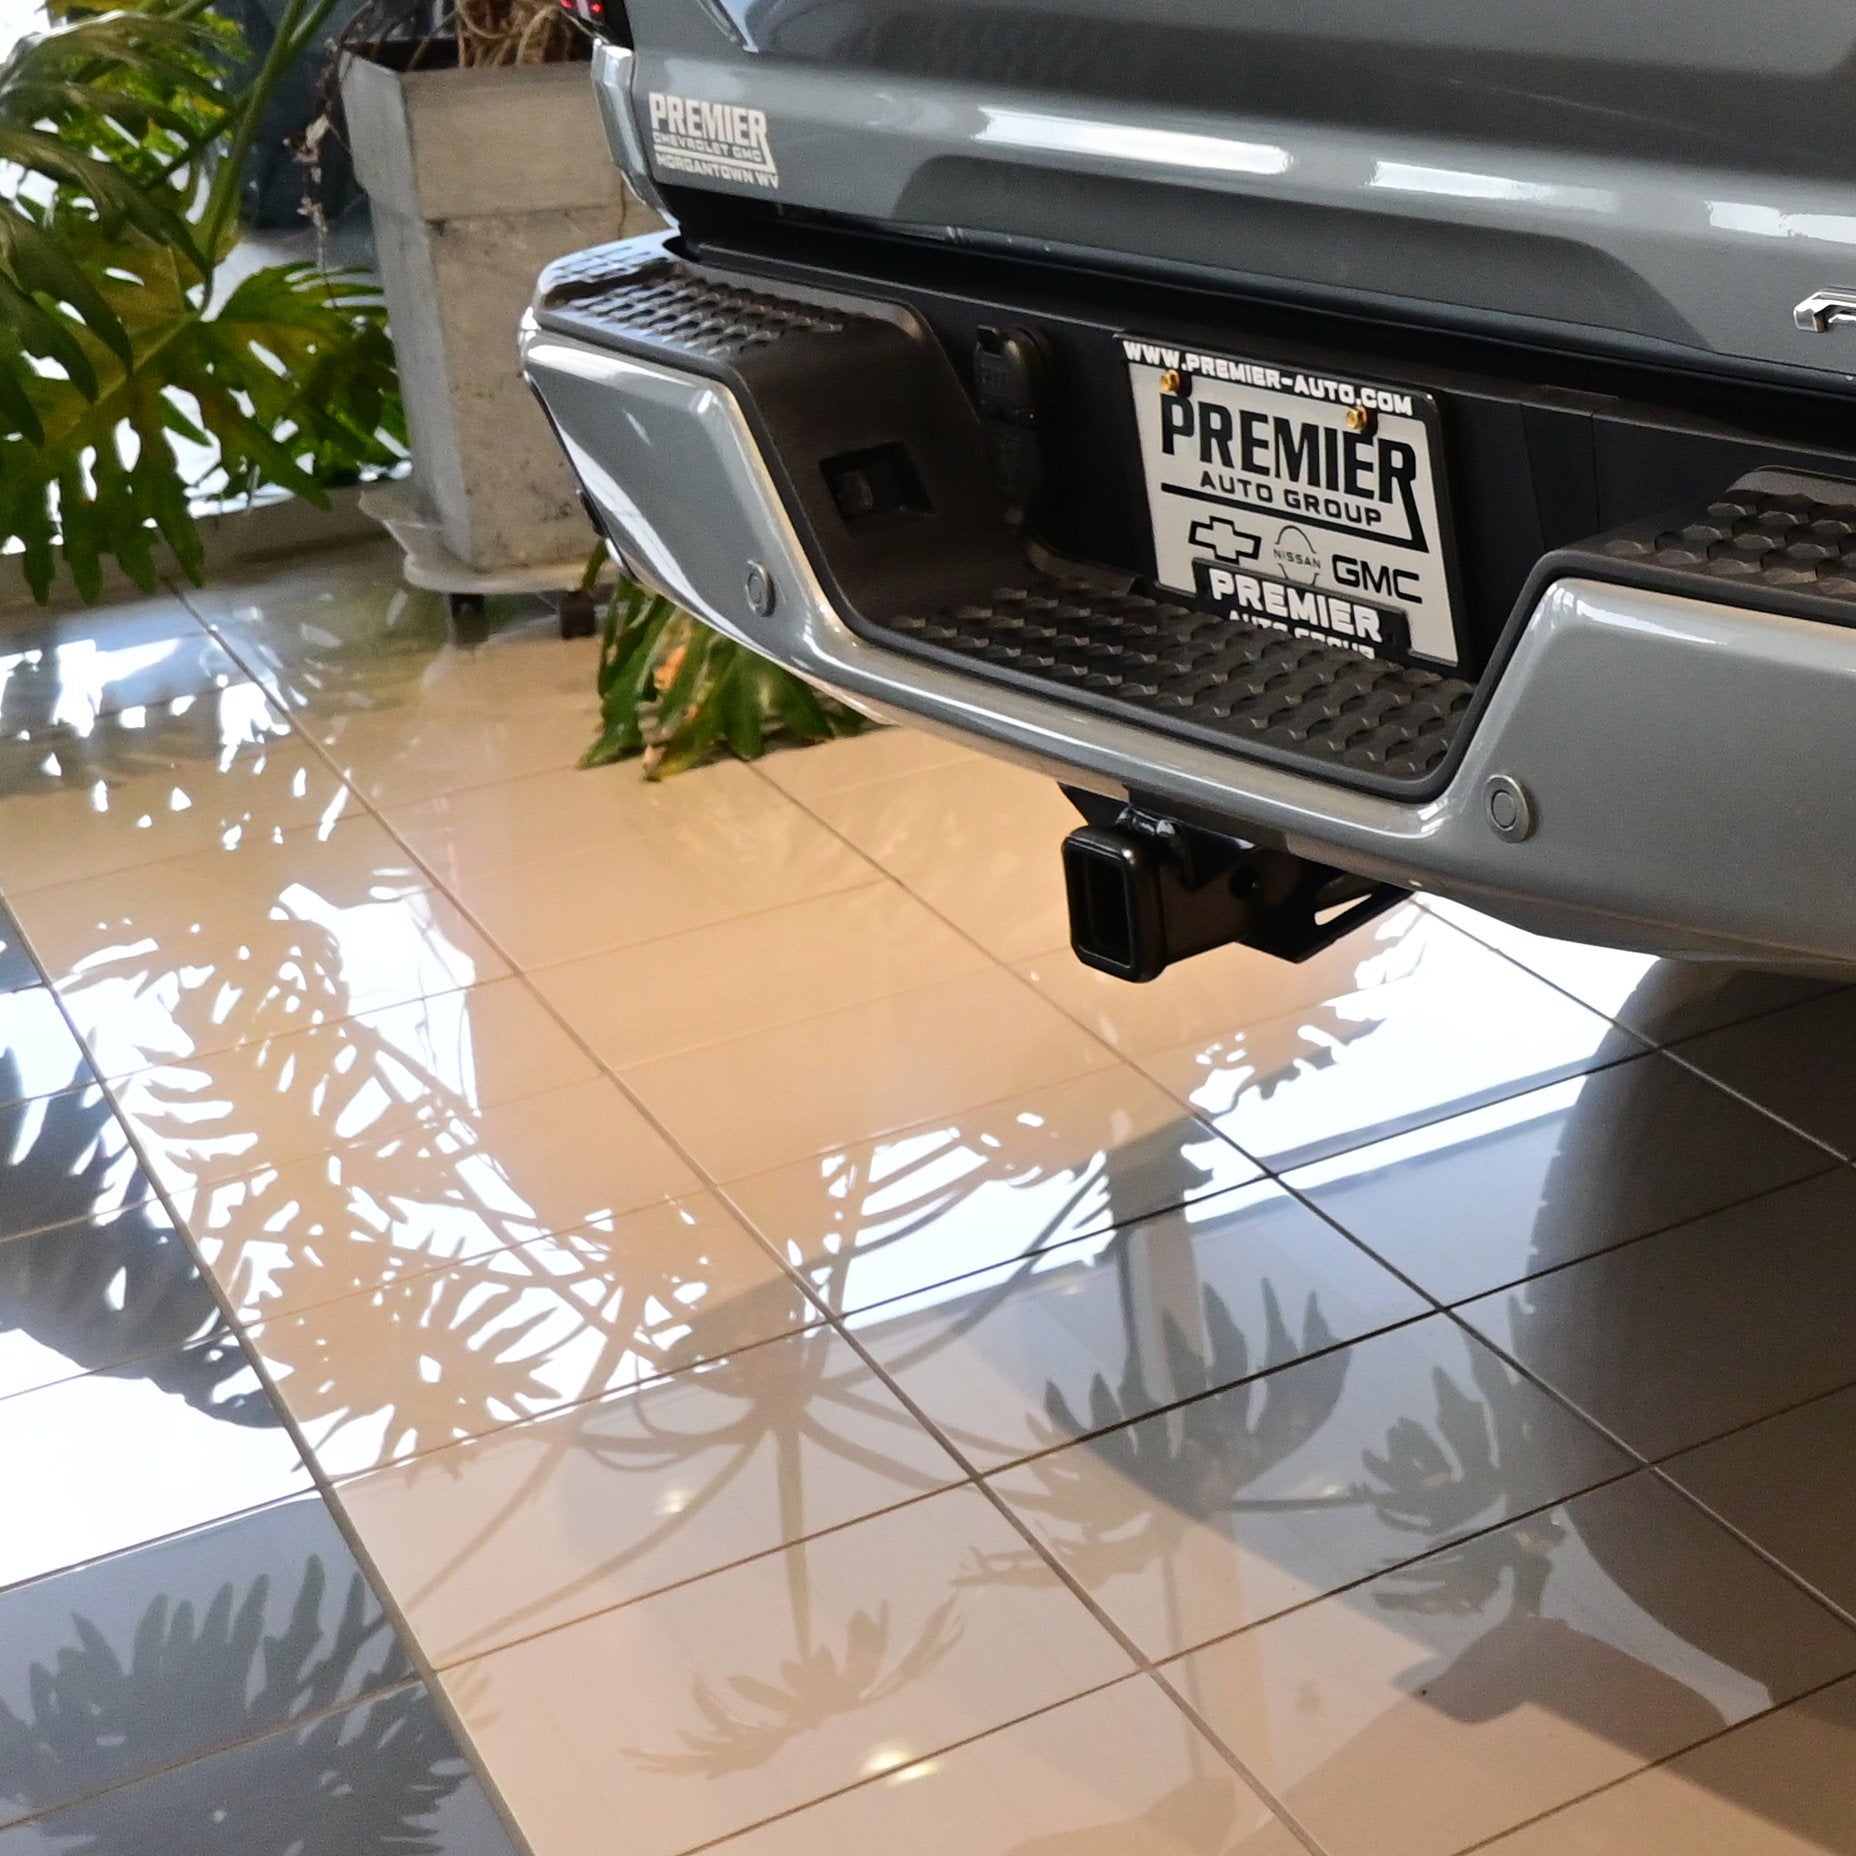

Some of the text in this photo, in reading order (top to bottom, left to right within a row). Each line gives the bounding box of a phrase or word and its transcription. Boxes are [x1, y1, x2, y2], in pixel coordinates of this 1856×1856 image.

[649, 93, 770, 149] PREMIER
[653, 131, 763, 163] CHEVROLET GMC
[656, 152, 779, 190] MORGANTOWN WV
[1122, 341, 1414, 417] WWW.PREMIER-AUTO.COM
[1159, 392, 1418, 505] PREMIER
[1199, 470, 1382, 526] AUTO GROUP
[1273, 548, 1423, 604] NISSAN GMC
[1209, 568, 1383, 643] PREMIER
